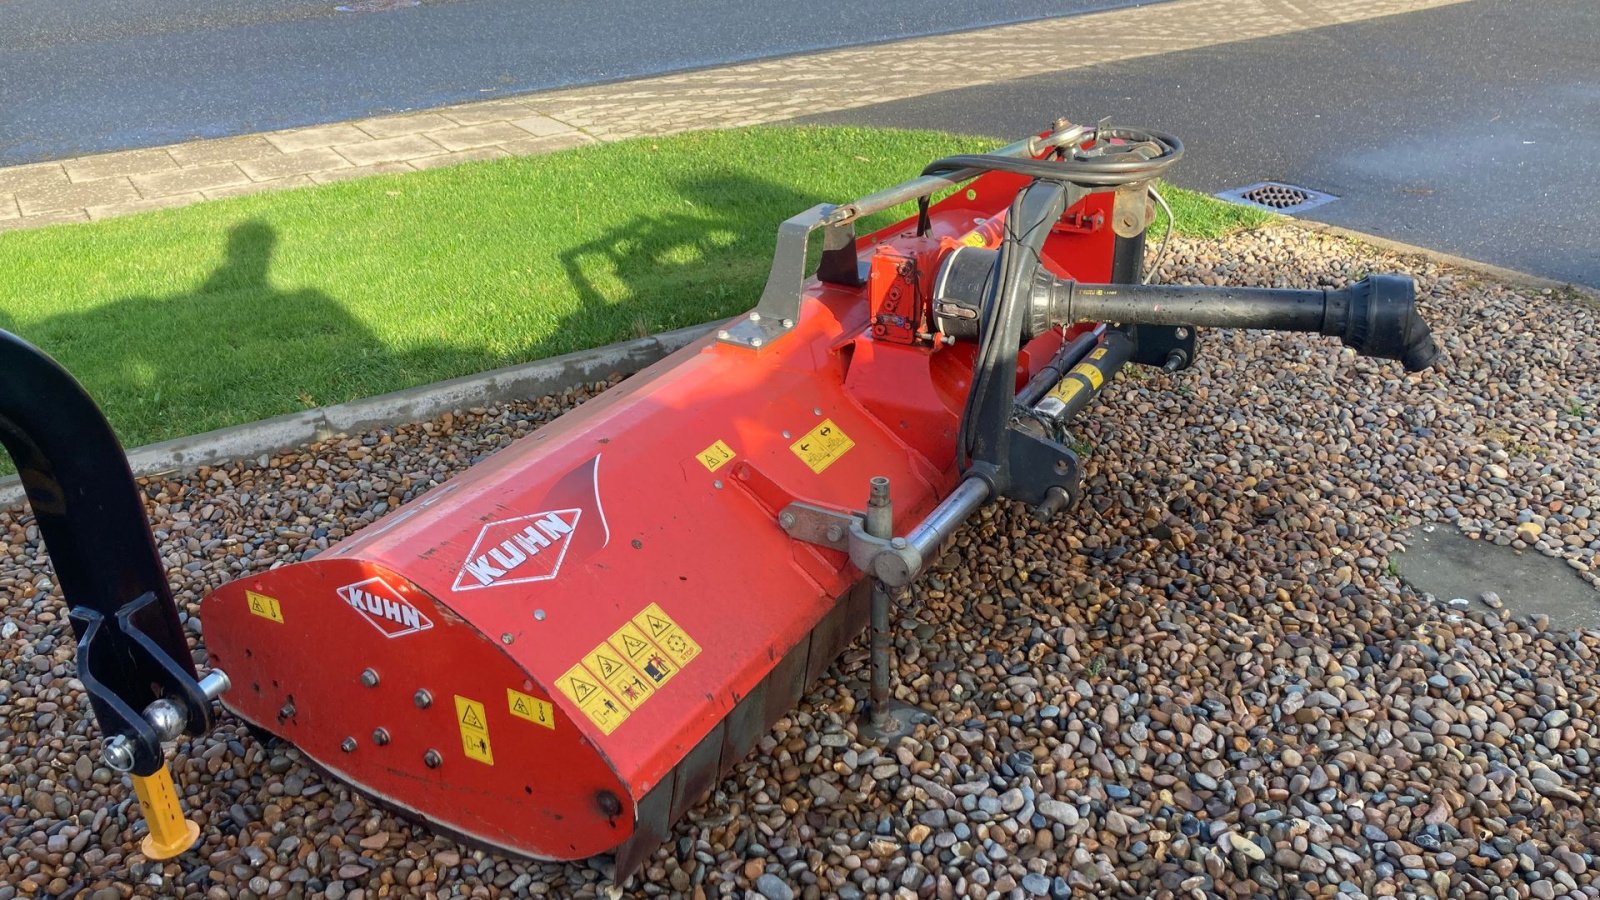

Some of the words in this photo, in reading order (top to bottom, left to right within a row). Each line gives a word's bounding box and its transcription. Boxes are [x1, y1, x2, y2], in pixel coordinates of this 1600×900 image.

[465, 512, 574, 586] KUHN
[348, 586, 421, 630] KUHN
[680, 646, 695, 661] STOP
